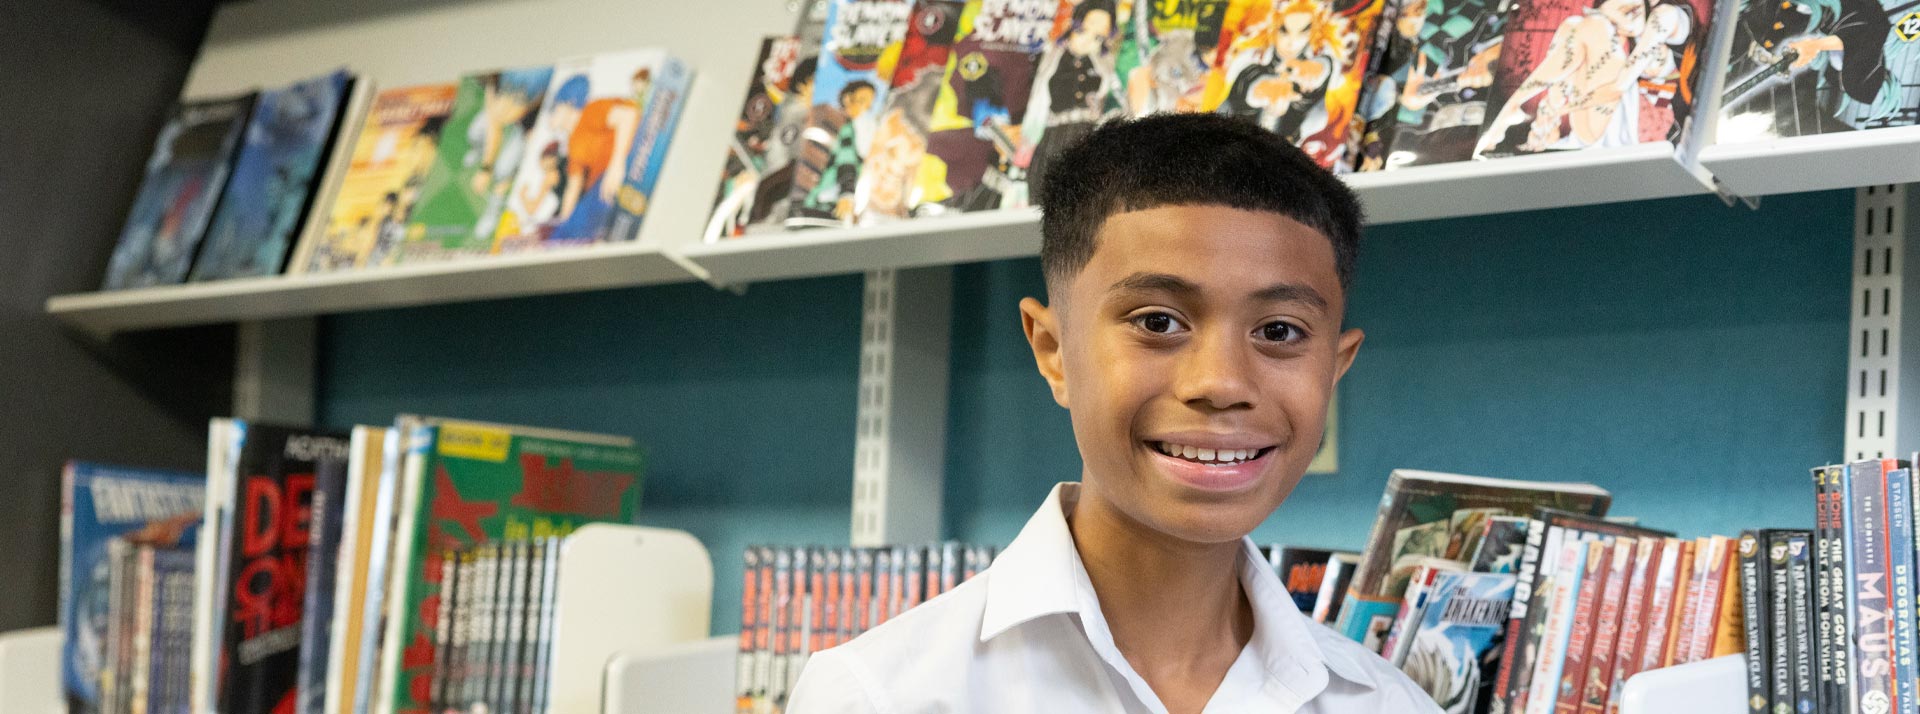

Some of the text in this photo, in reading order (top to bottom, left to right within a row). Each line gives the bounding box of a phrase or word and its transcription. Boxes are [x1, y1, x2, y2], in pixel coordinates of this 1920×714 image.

[1903, 18, 1920, 35] 12
[1830, 471, 1839, 484] 2
[1892, 482, 1903, 528] STASSEN
[1509, 519, 1545, 619] MANGA
[1864, 496, 1874, 564] THE COMPLETE
[1817, 493, 1832, 682] BONE OUT FROM BONEVILLE
[1831, 492, 1847, 685] BONE THE GREAT COW RAGE
[1857, 572, 1890, 678] MAUS
[1895, 565, 1911, 666] DEOGRATIAS
